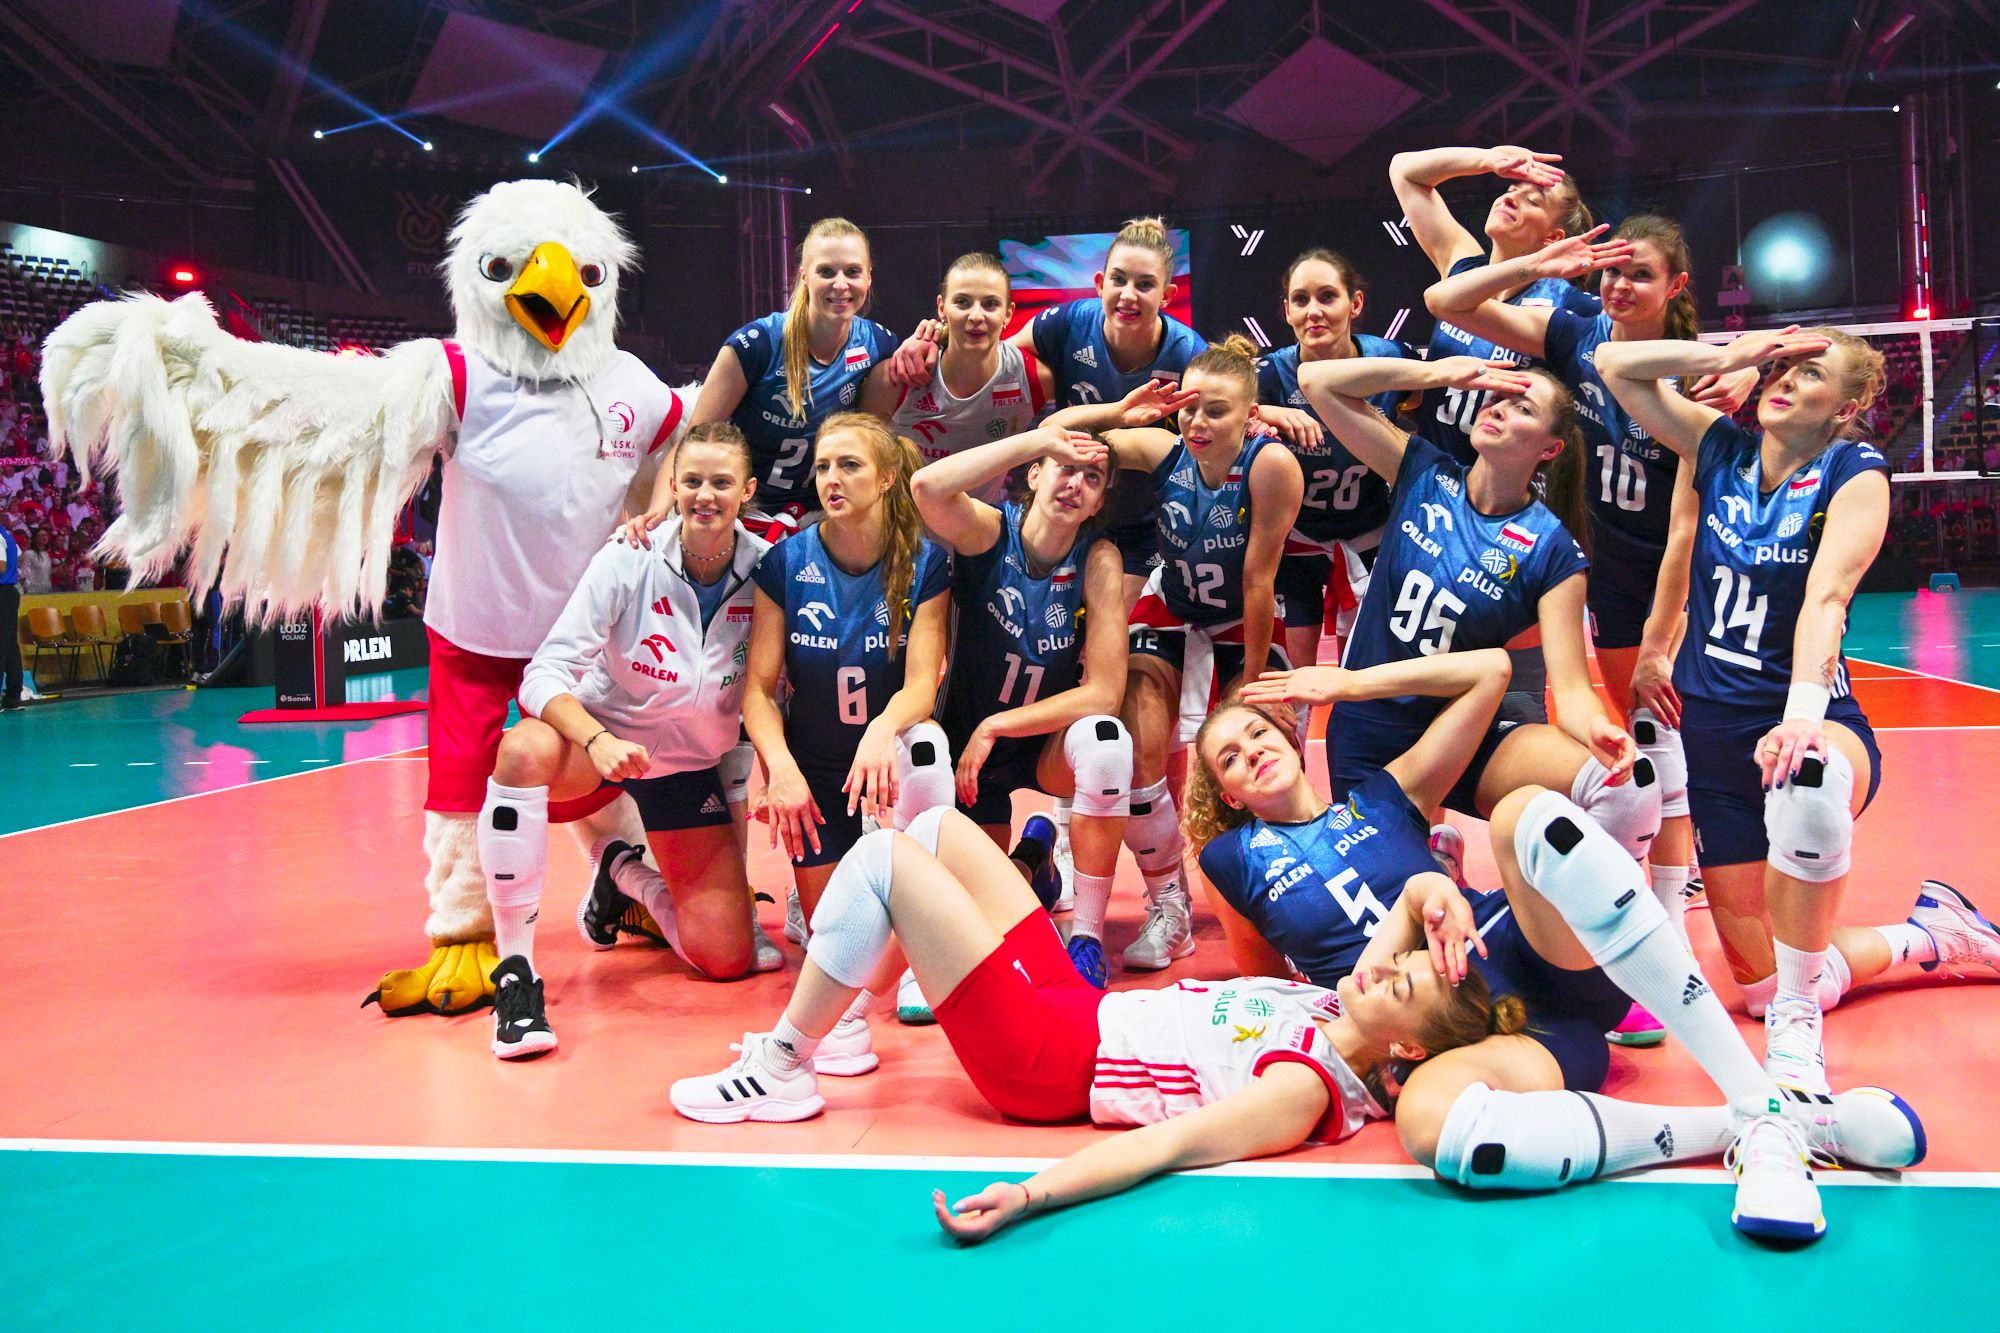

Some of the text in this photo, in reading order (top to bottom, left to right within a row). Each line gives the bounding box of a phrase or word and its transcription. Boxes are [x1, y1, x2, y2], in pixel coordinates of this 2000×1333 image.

[407, 262, 437, 275] FIV
[1439, 320, 1474, 347] ORLEN
[845, 361, 872, 373] POLSKA
[1072, 352, 1099, 369] adidas
[1490, 345, 1533, 368] plus
[913, 402, 940, 414] adidas
[992, 397, 1024, 407] POLSKA
[762, 410, 806, 430] ORLEN
[919, 447, 950, 459] LEN
[1621, 437, 1661, 461] plus
[1859, 451, 1884, 461] ORLEN
[1168, 474, 1196, 492] adidas
[1435, 474, 1458, 498] adidas
[1596, 444, 1647, 513] 10
[1203, 532, 1245, 553] plus
[1401, 520, 1443, 558] ORLEN
[1706, 513, 1744, 549] ORLEN
[1495, 535, 1534, 554] POLSKA
[1754, 542, 1809, 565] plus
[795, 573, 827, 585] adidas
[1175, 558, 1227, 609] 12
[1456, 566, 1505, 601] plus
[987, 601, 1024, 639] ORLEN
[1389, 569, 1468, 656] 95
[1708, 565, 1769, 653] 14
[790, 631, 839, 650] ORLEN
[1037, 633, 1077, 655] plus
[1135, 629, 1158, 650] 12
[631, 661, 679, 683] ORLEN
[998, 652, 1046, 708] 11
[836, 666, 868, 726] 6
[1250, 836, 1284, 849] adidas
[1333, 825, 1379, 857] plus
[1268, 862, 1314, 902] ORLEN
[1324, 866, 1390, 938] 5
